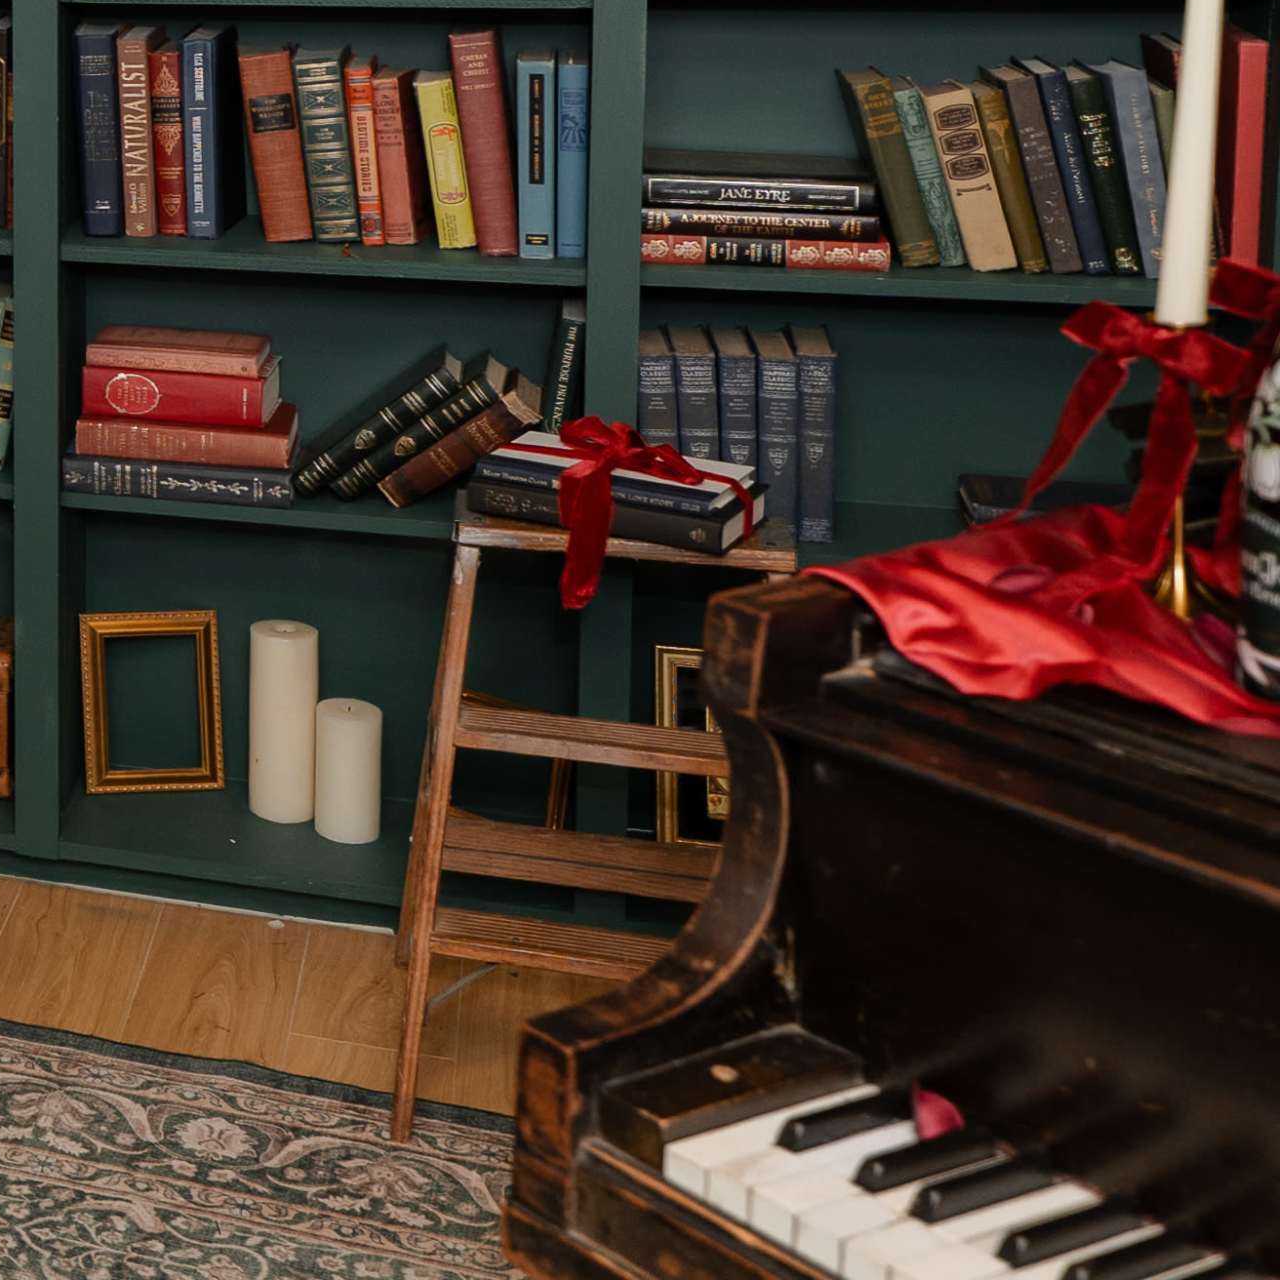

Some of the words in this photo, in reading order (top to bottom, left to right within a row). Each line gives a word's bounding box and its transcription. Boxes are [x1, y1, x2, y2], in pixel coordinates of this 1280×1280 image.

[467, 60, 484, 68] AND
[462, 68, 489, 76] CHRIST
[120, 61, 149, 177] NATURALIST
[356, 115, 369, 153] BEDTIME
[358, 156, 371, 192] STORIES
[718, 187, 752, 200] JANE
[755, 189, 791, 202] EYRE
[689, 214, 740, 224] JOURNEY
[743, 215, 758, 225] TO
[759, 215, 784, 226] THE
[785, 217, 830, 228] CENTER
[567, 325, 579, 340] THE
[558, 342, 577, 383] PURPOSE
[552, 384, 570, 420] DRIVEN
[627, 492, 648, 504] LOVE
